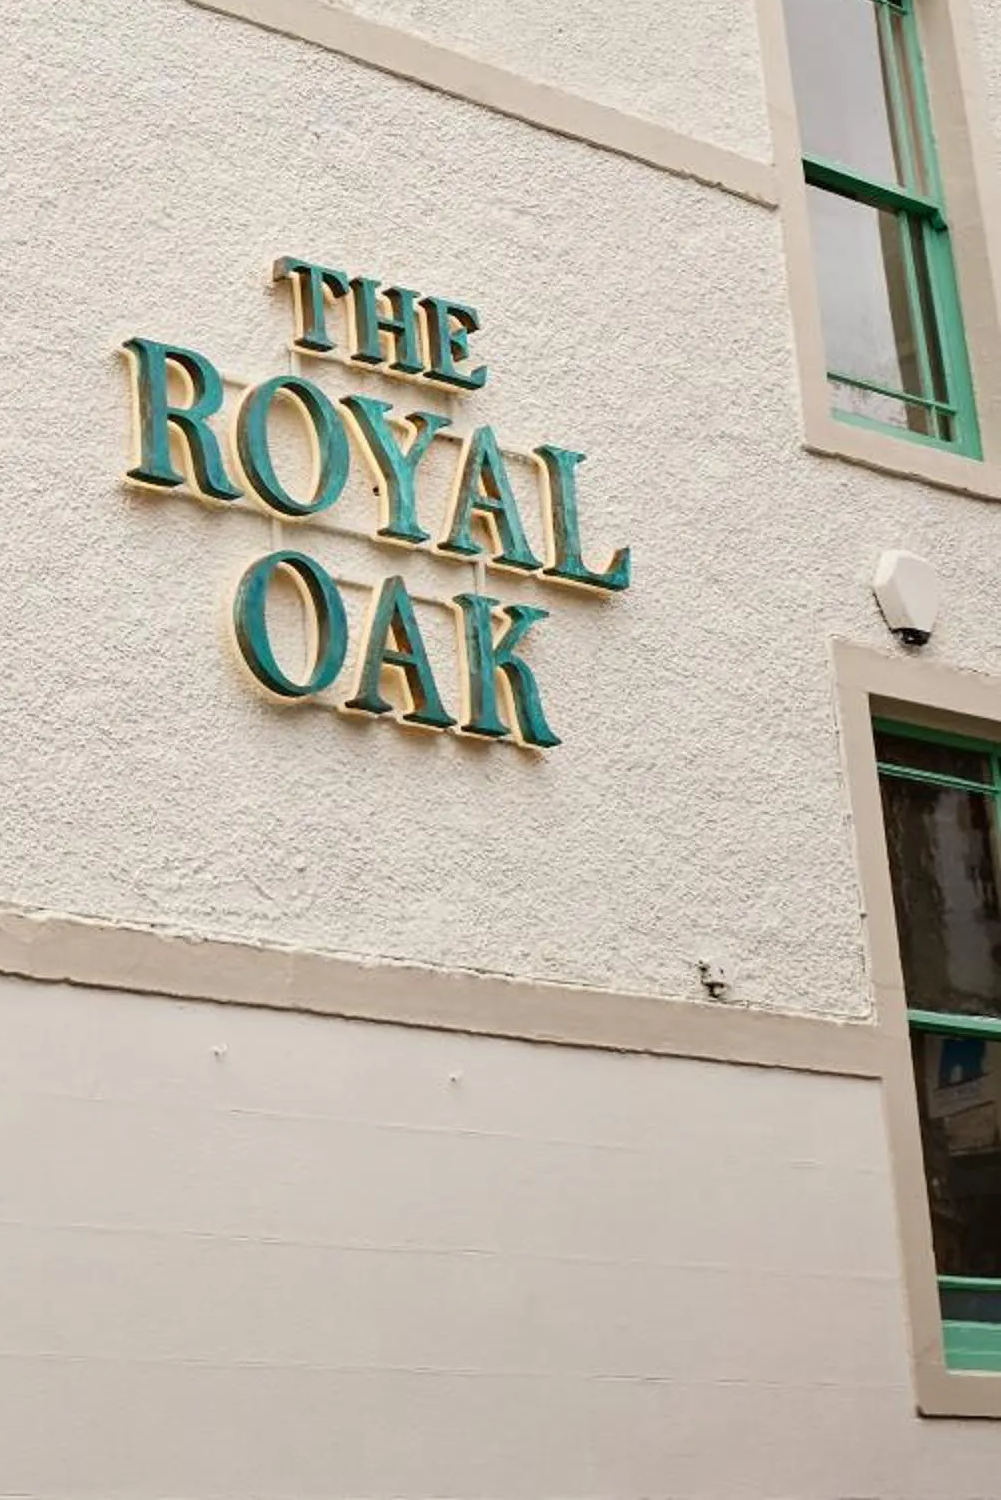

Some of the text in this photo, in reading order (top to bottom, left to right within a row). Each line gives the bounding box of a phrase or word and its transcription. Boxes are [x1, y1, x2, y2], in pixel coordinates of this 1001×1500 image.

[273, 256, 488, 390] THE
[121, 337, 632, 591] ROYAL
[234, 550, 562, 748] OAK
